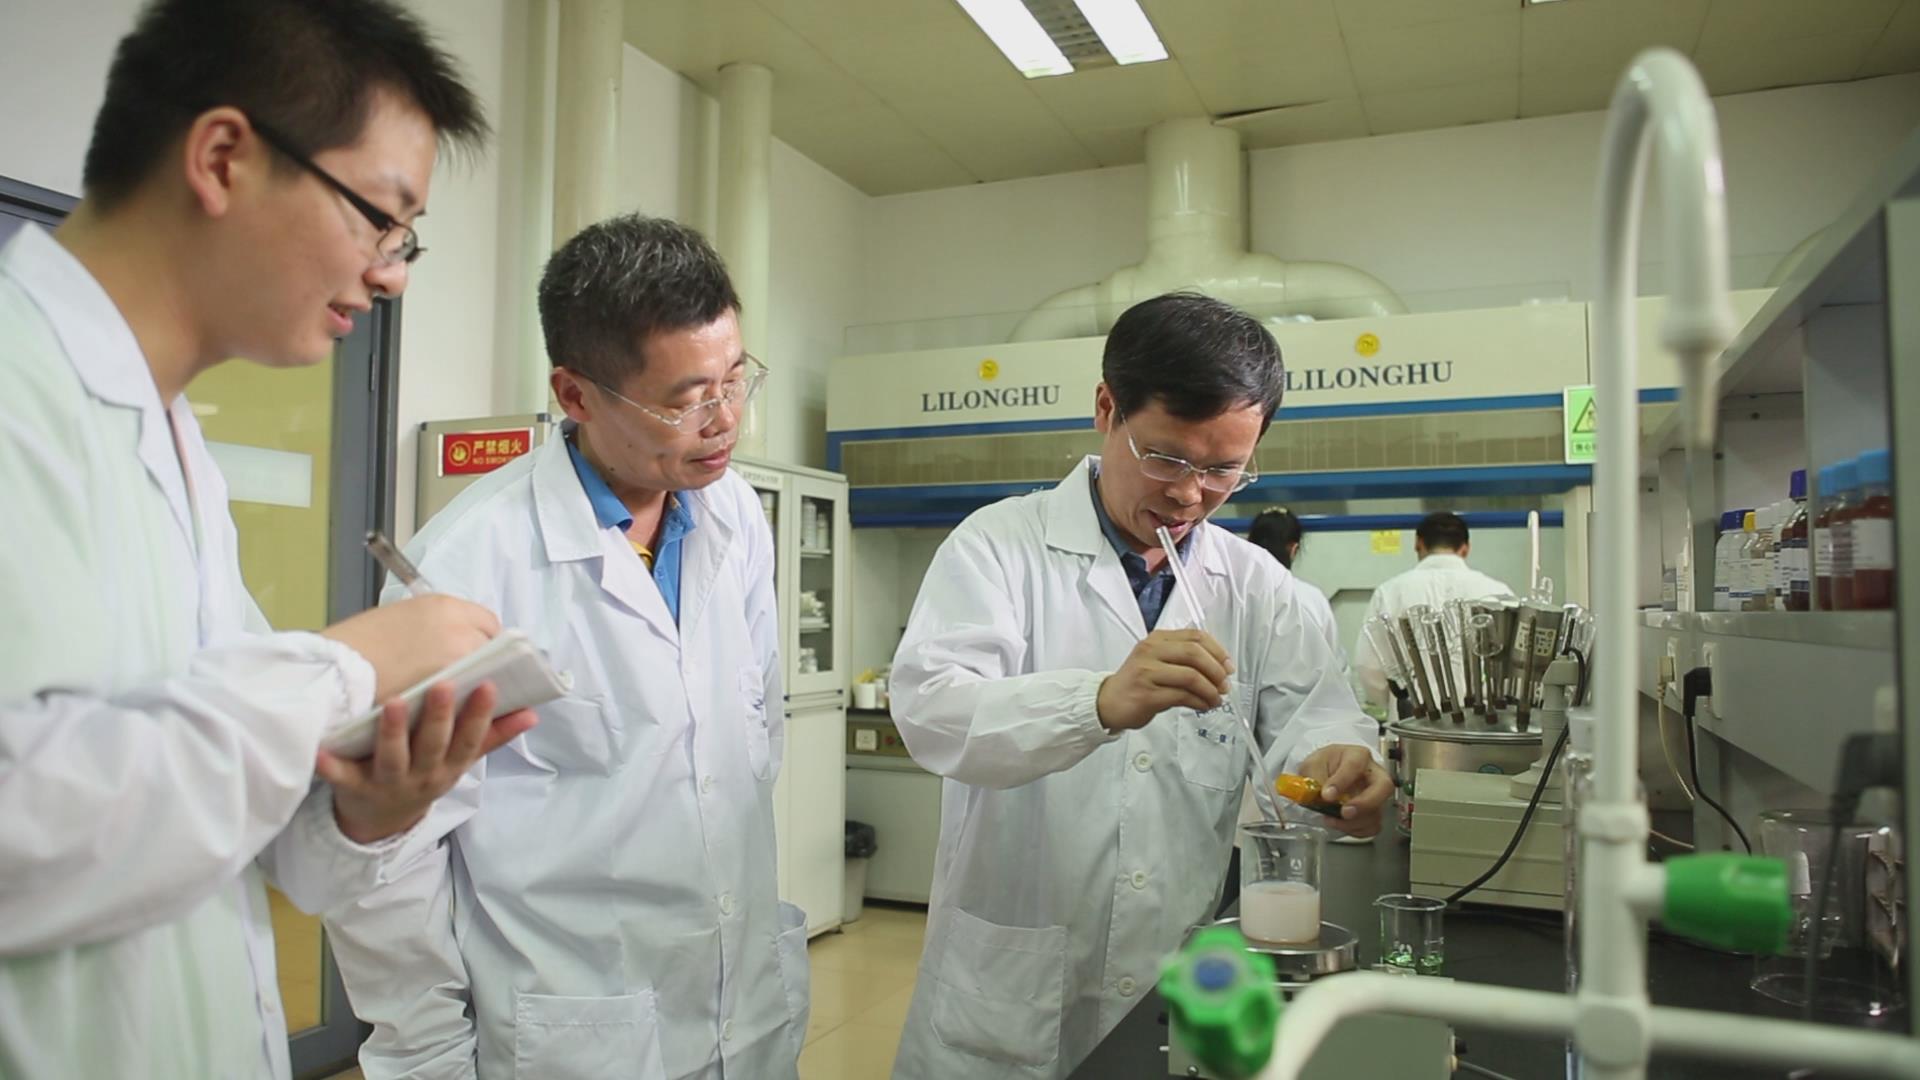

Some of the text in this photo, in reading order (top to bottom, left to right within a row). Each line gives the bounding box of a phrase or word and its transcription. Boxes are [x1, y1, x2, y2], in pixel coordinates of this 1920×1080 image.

[1286, 361, 1452, 391] LILONGHU
[921, 385, 1060, 412] LILONGHU
[473, 438, 522, 455] 严禁烟火
[473, 457, 484, 465] NO
